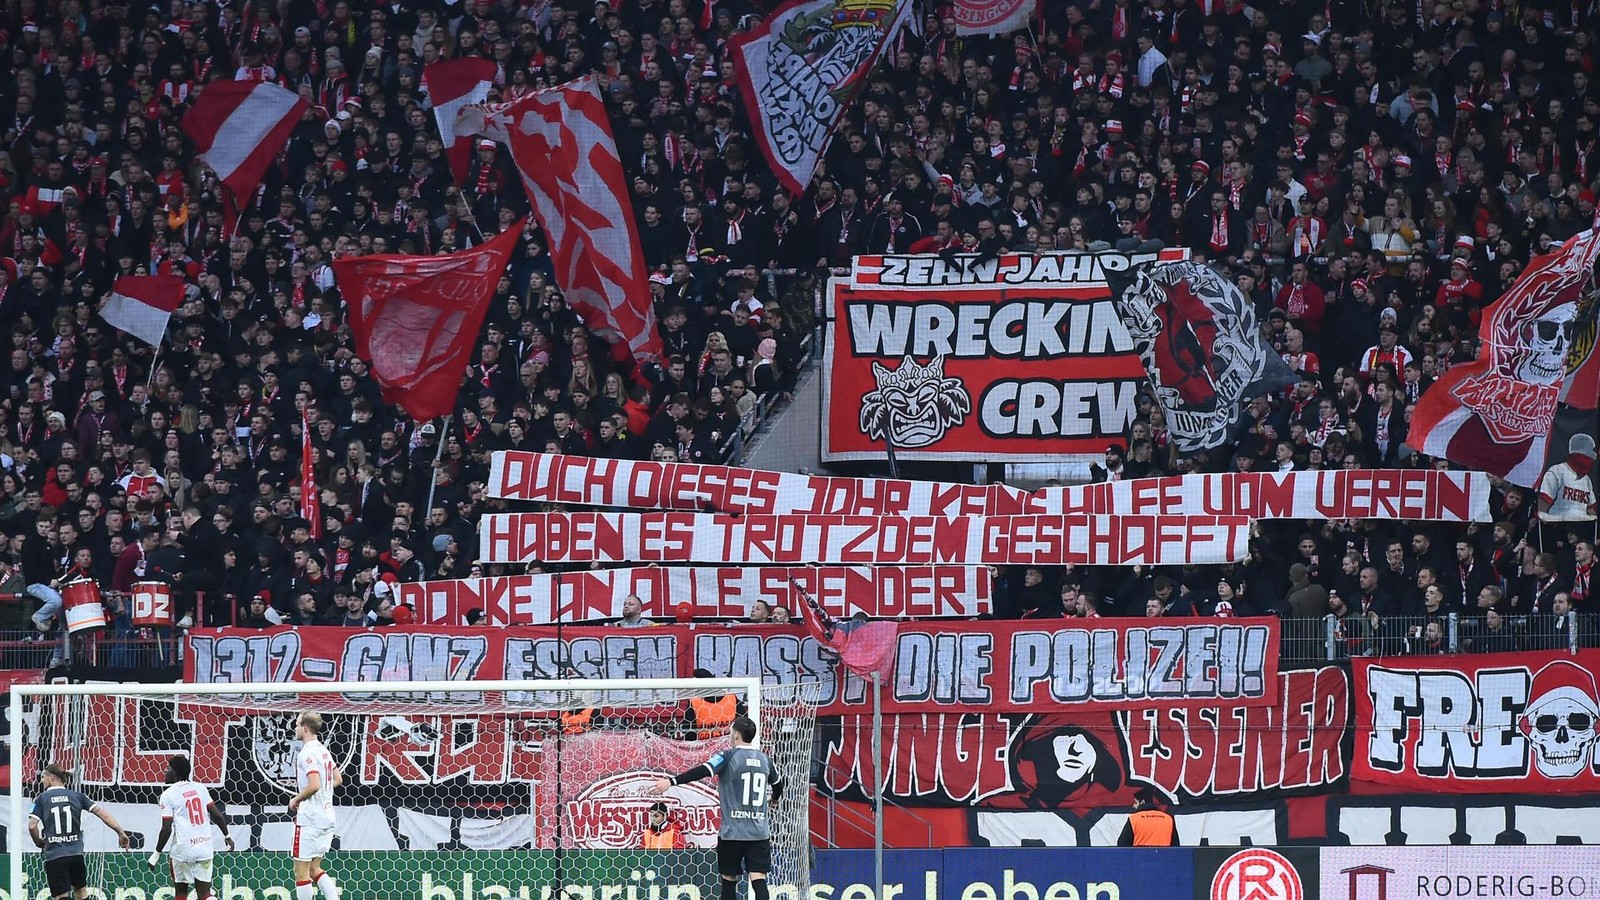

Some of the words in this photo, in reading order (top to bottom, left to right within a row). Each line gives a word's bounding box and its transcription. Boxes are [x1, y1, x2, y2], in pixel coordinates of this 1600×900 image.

[880, 256, 999, 285] ZEHN
[847, 299, 1135, 358] WRECKIN
[979, 380, 1138, 438] CREW
[501, 451, 613, 503] AUCH
[629, 461, 780, 514] DIESES
[791, 475, 911, 516] JAHR
[929, 482, 1047, 515] KEINE
[1202, 470, 1297, 517] VOM
[1315, 468, 1473, 522] VEREIN
[489, 514, 624, 562] HABEN
[639, 513, 696, 562] ES
[712, 514, 969, 563] TROTZDEM
[980, 514, 1249, 564] GESCHAFFT
[399, 575, 534, 626] DANKE
[550, 570, 615, 622] AN
[629, 566, 744, 616] ALLE
[759, 566, 990, 616] SPENDER!
[504, 635, 679, 706] ESSEN
[895, 631, 994, 704] DIE
[1010, 625, 1268, 703] POLIZEI!!
[823, 711, 1031, 806] JUNGE
[1115, 667, 1350, 805] ESSENER
[185, 796, 205, 827] 19
[741, 772, 766, 807] 19
[50, 805, 72, 835] 11
